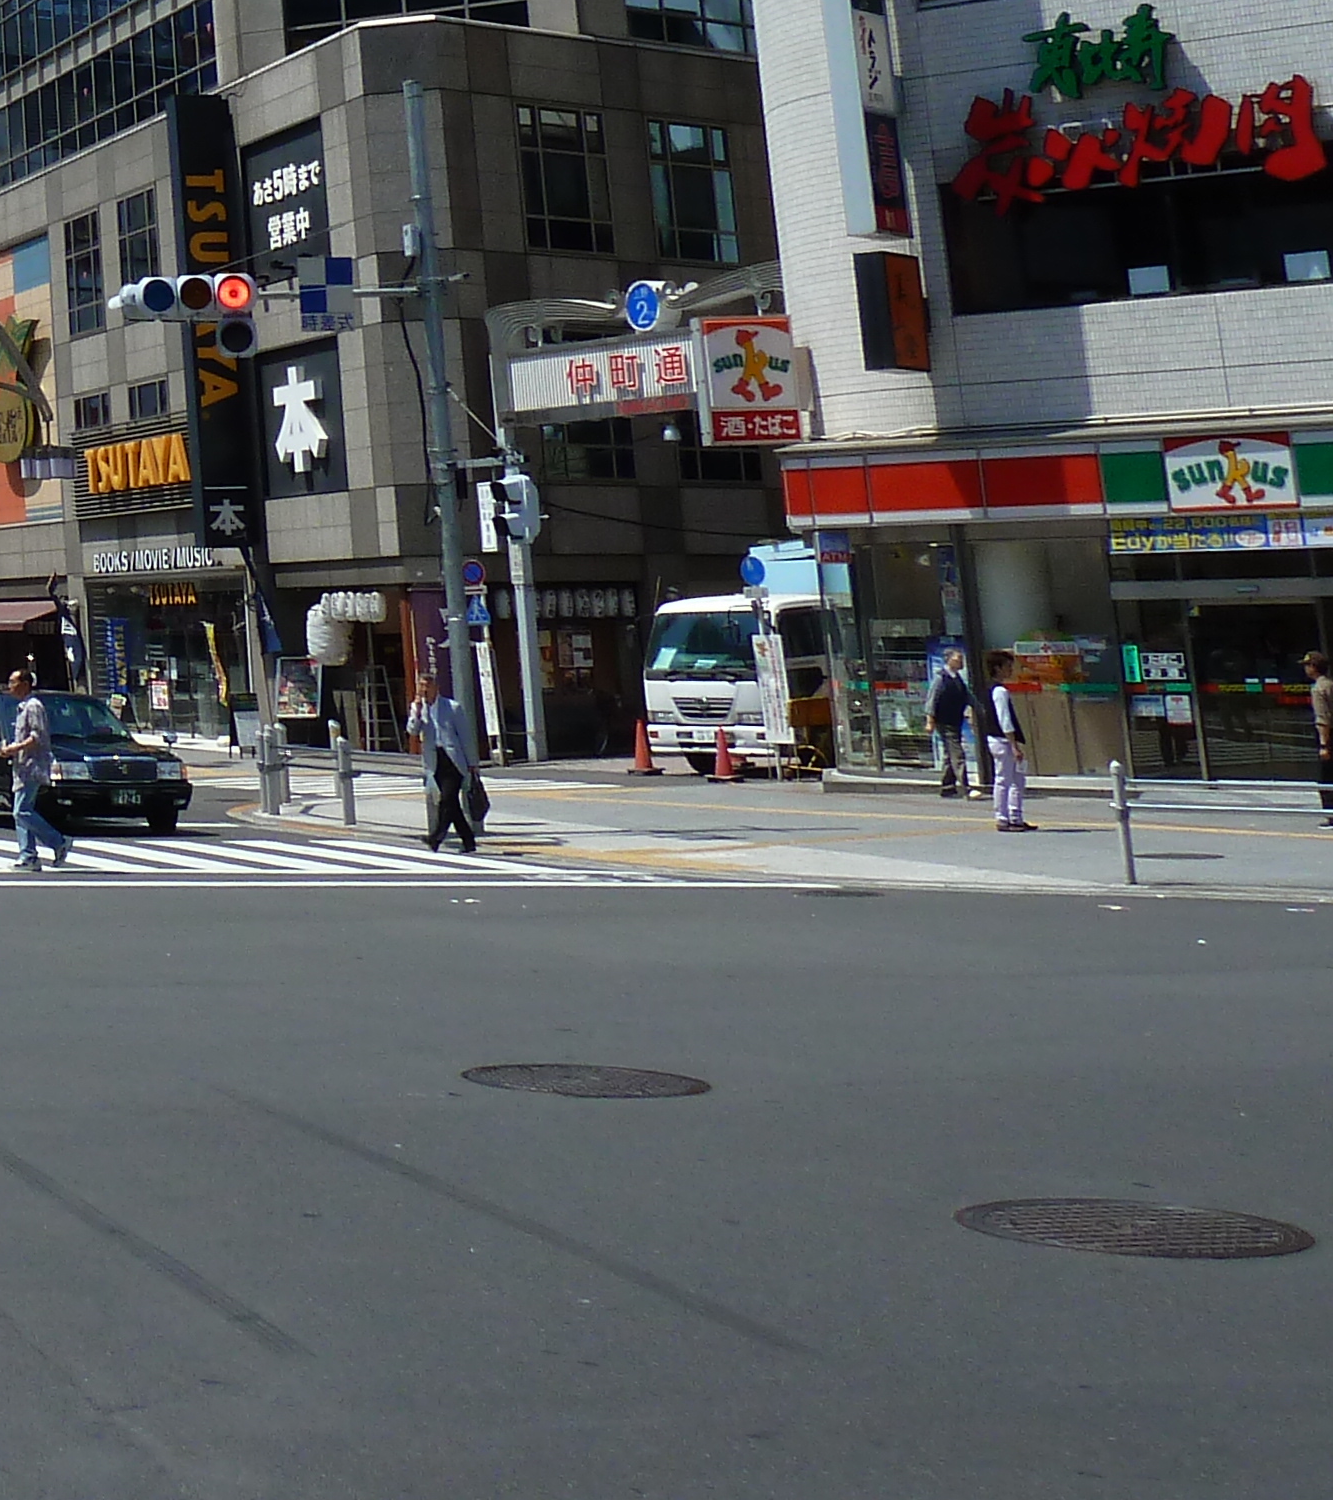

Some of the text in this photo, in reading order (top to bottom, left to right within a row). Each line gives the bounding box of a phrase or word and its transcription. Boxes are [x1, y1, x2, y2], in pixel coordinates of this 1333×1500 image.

[252, 160, 322, 206] あさ5時まで
[267, 206, 310, 250] 営業中
[636, 300, 651, 324] 2
[567, 346, 688, 395] 仲町通
[273, 367, 329, 472] 本
[720, 412, 799, 439] 酒・たばこ
[84, 434, 191, 494] TSUTAYA
[210, 499, 245, 535] 本
